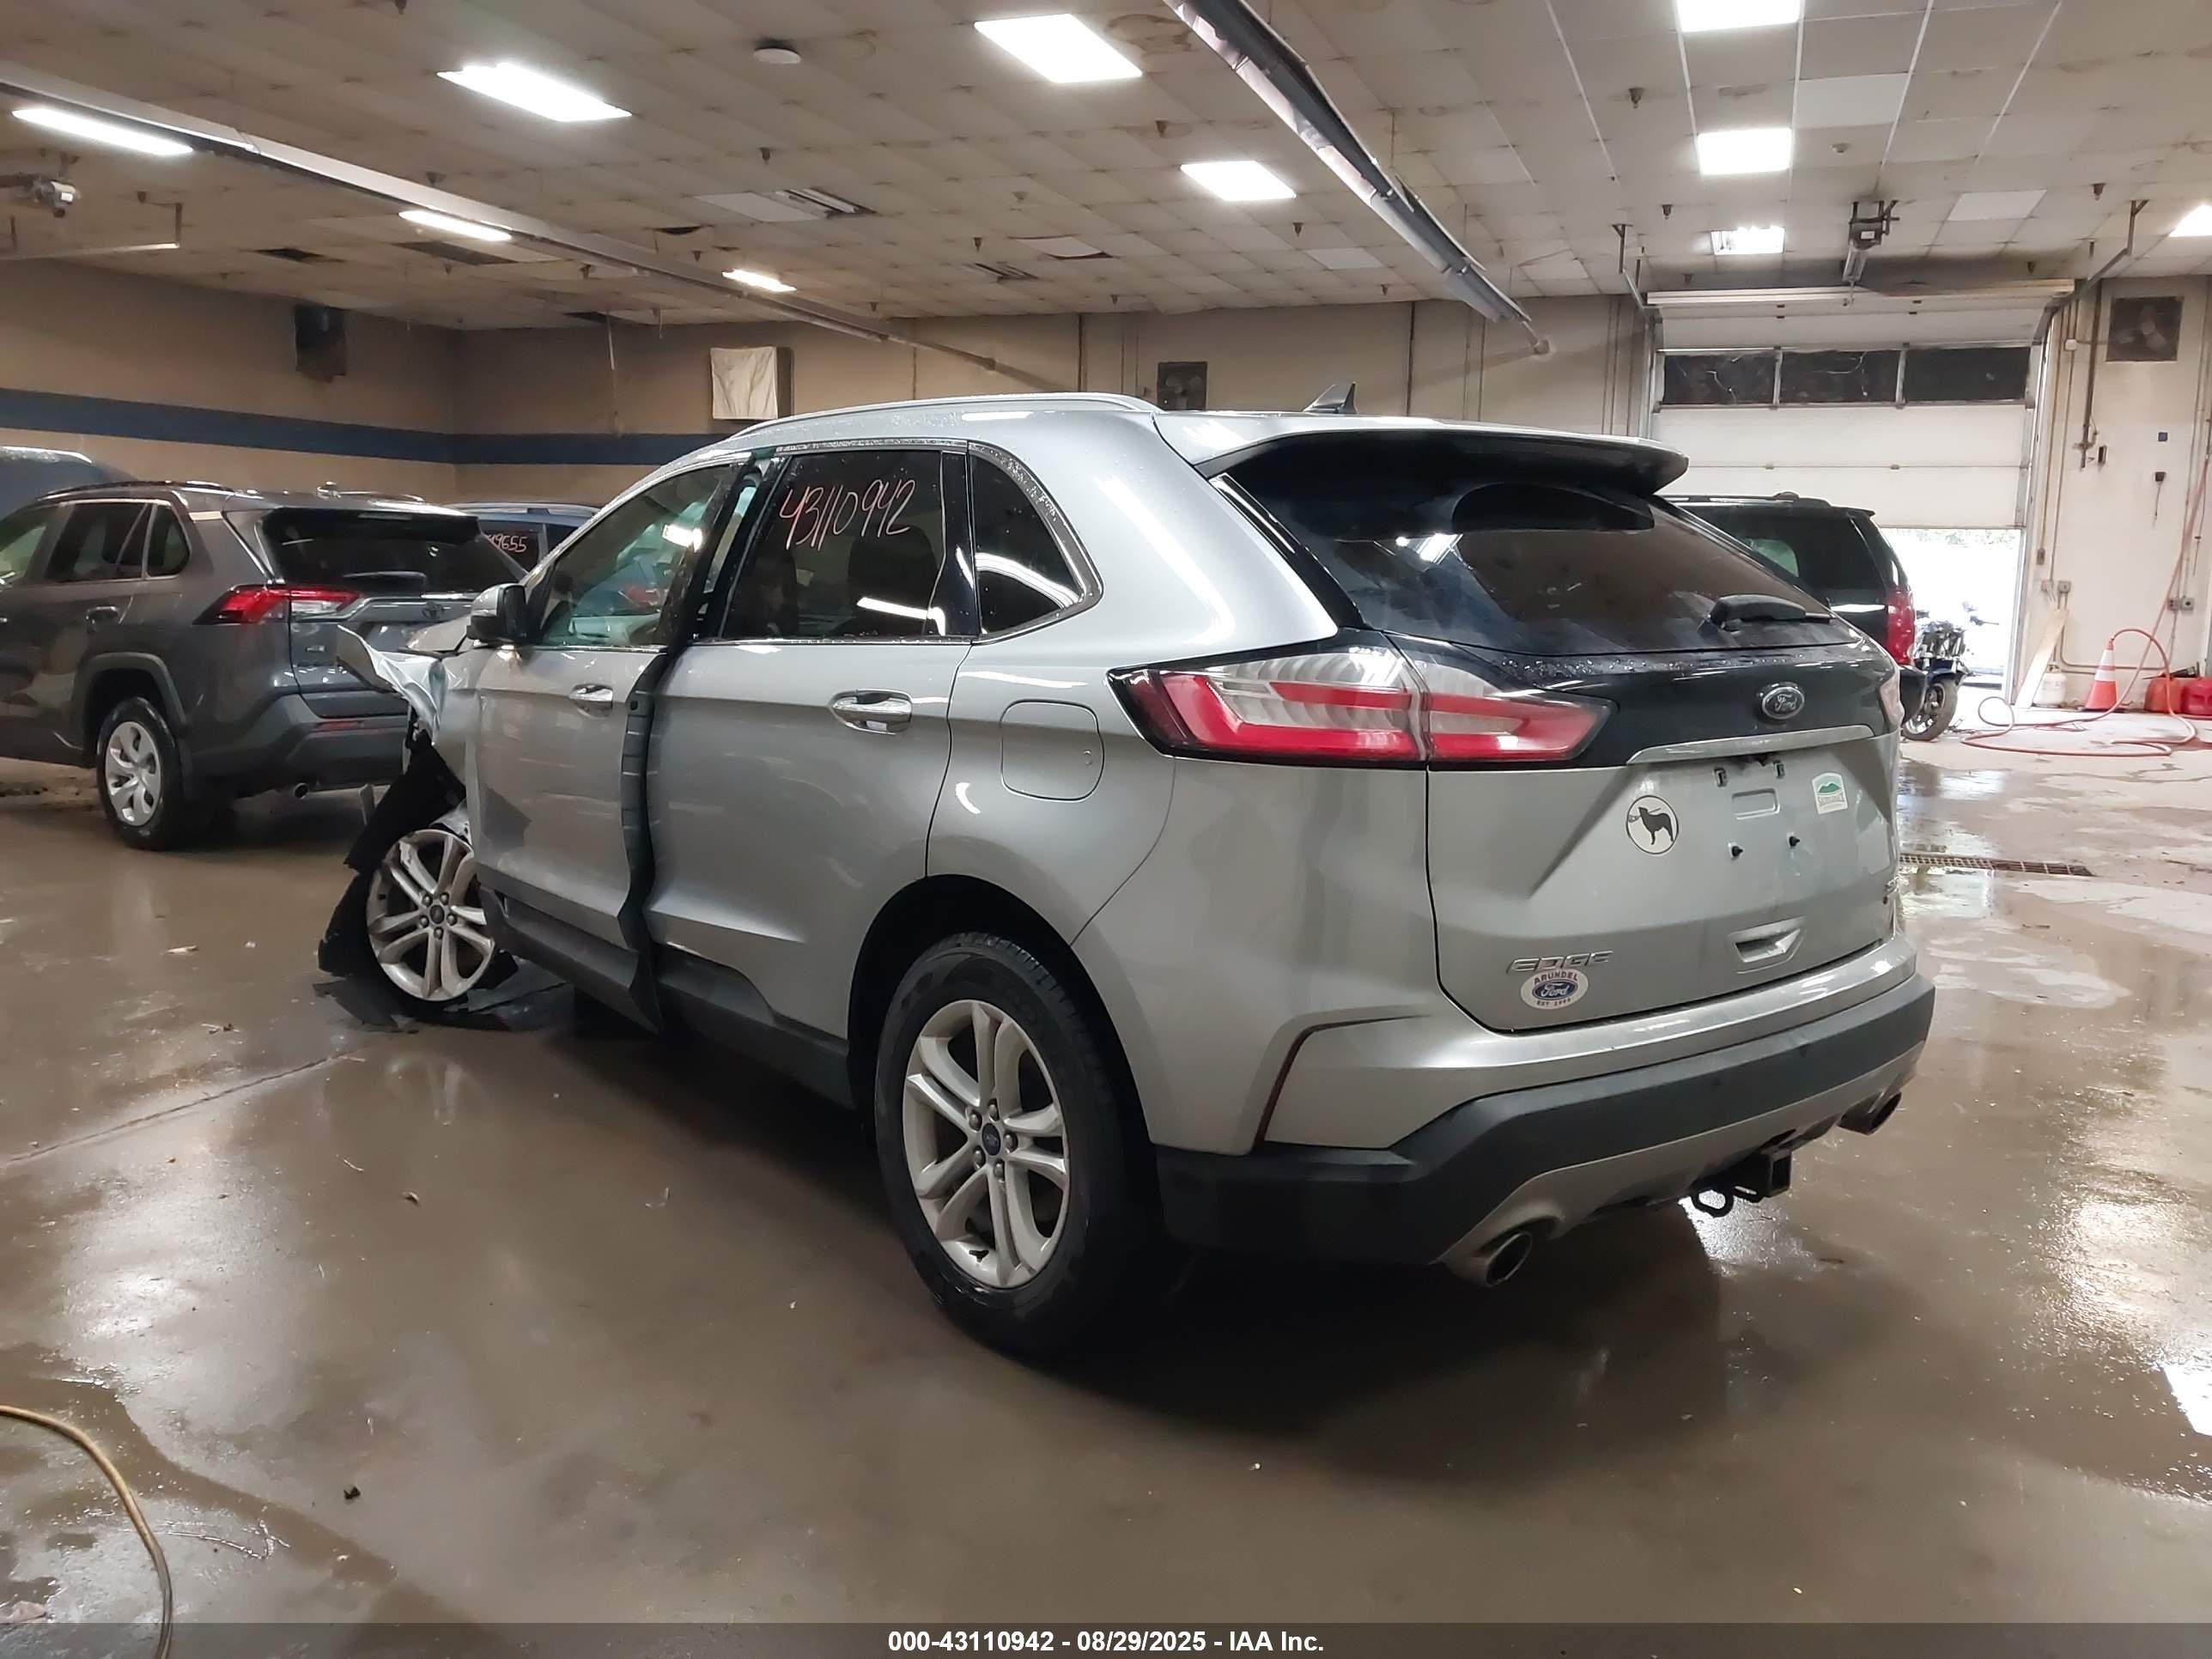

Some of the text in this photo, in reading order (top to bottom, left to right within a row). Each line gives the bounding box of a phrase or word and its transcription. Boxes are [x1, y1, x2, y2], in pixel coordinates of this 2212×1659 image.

[779, 478, 915, 551] 43110942
[1506, 949, 1613, 974] EDGE
[1534, 970, 1578, 985] ARUNDEL
[1540, 981, 1571, 997] Ford
